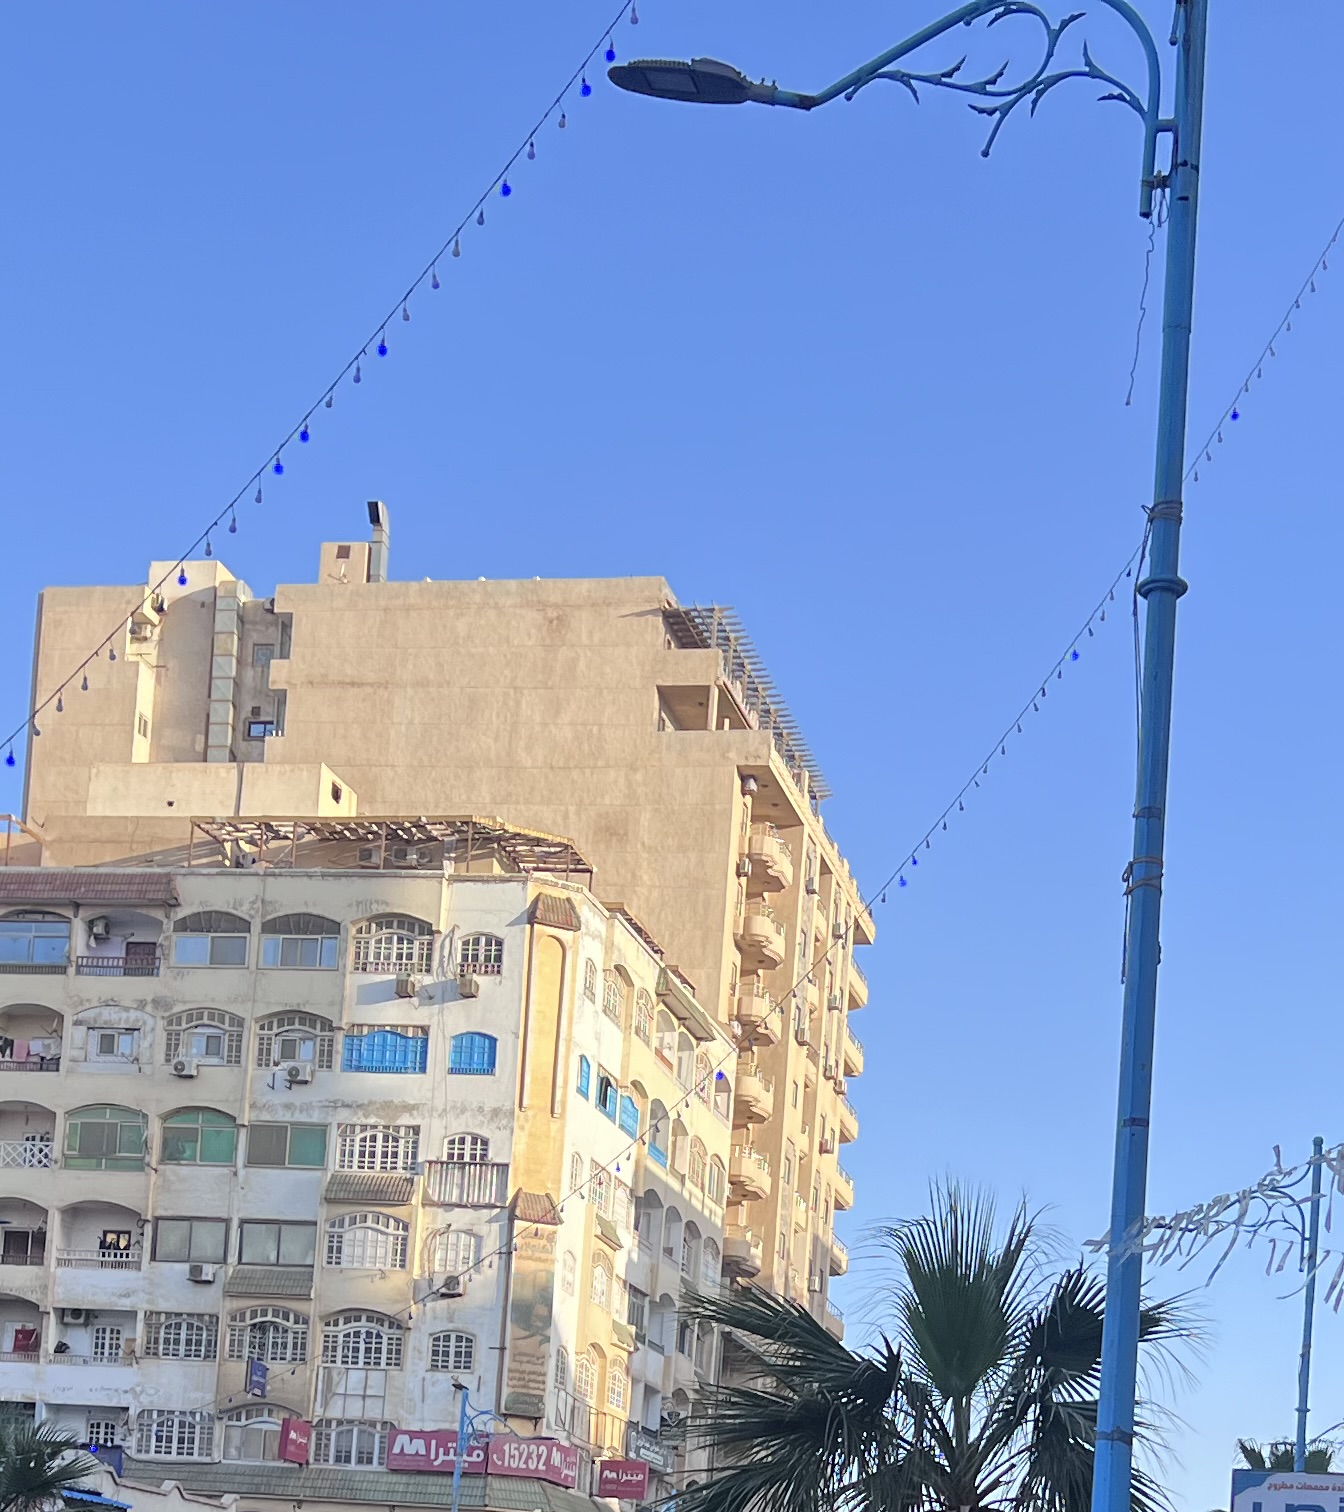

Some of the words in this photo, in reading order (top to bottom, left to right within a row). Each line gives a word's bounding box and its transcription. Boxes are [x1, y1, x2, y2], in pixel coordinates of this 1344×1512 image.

[503, 1442, 548, 1471] 15232
[618, 1468, 644, 1483] ميترا
[1267, 1481, 1294, 1491] مطروح
